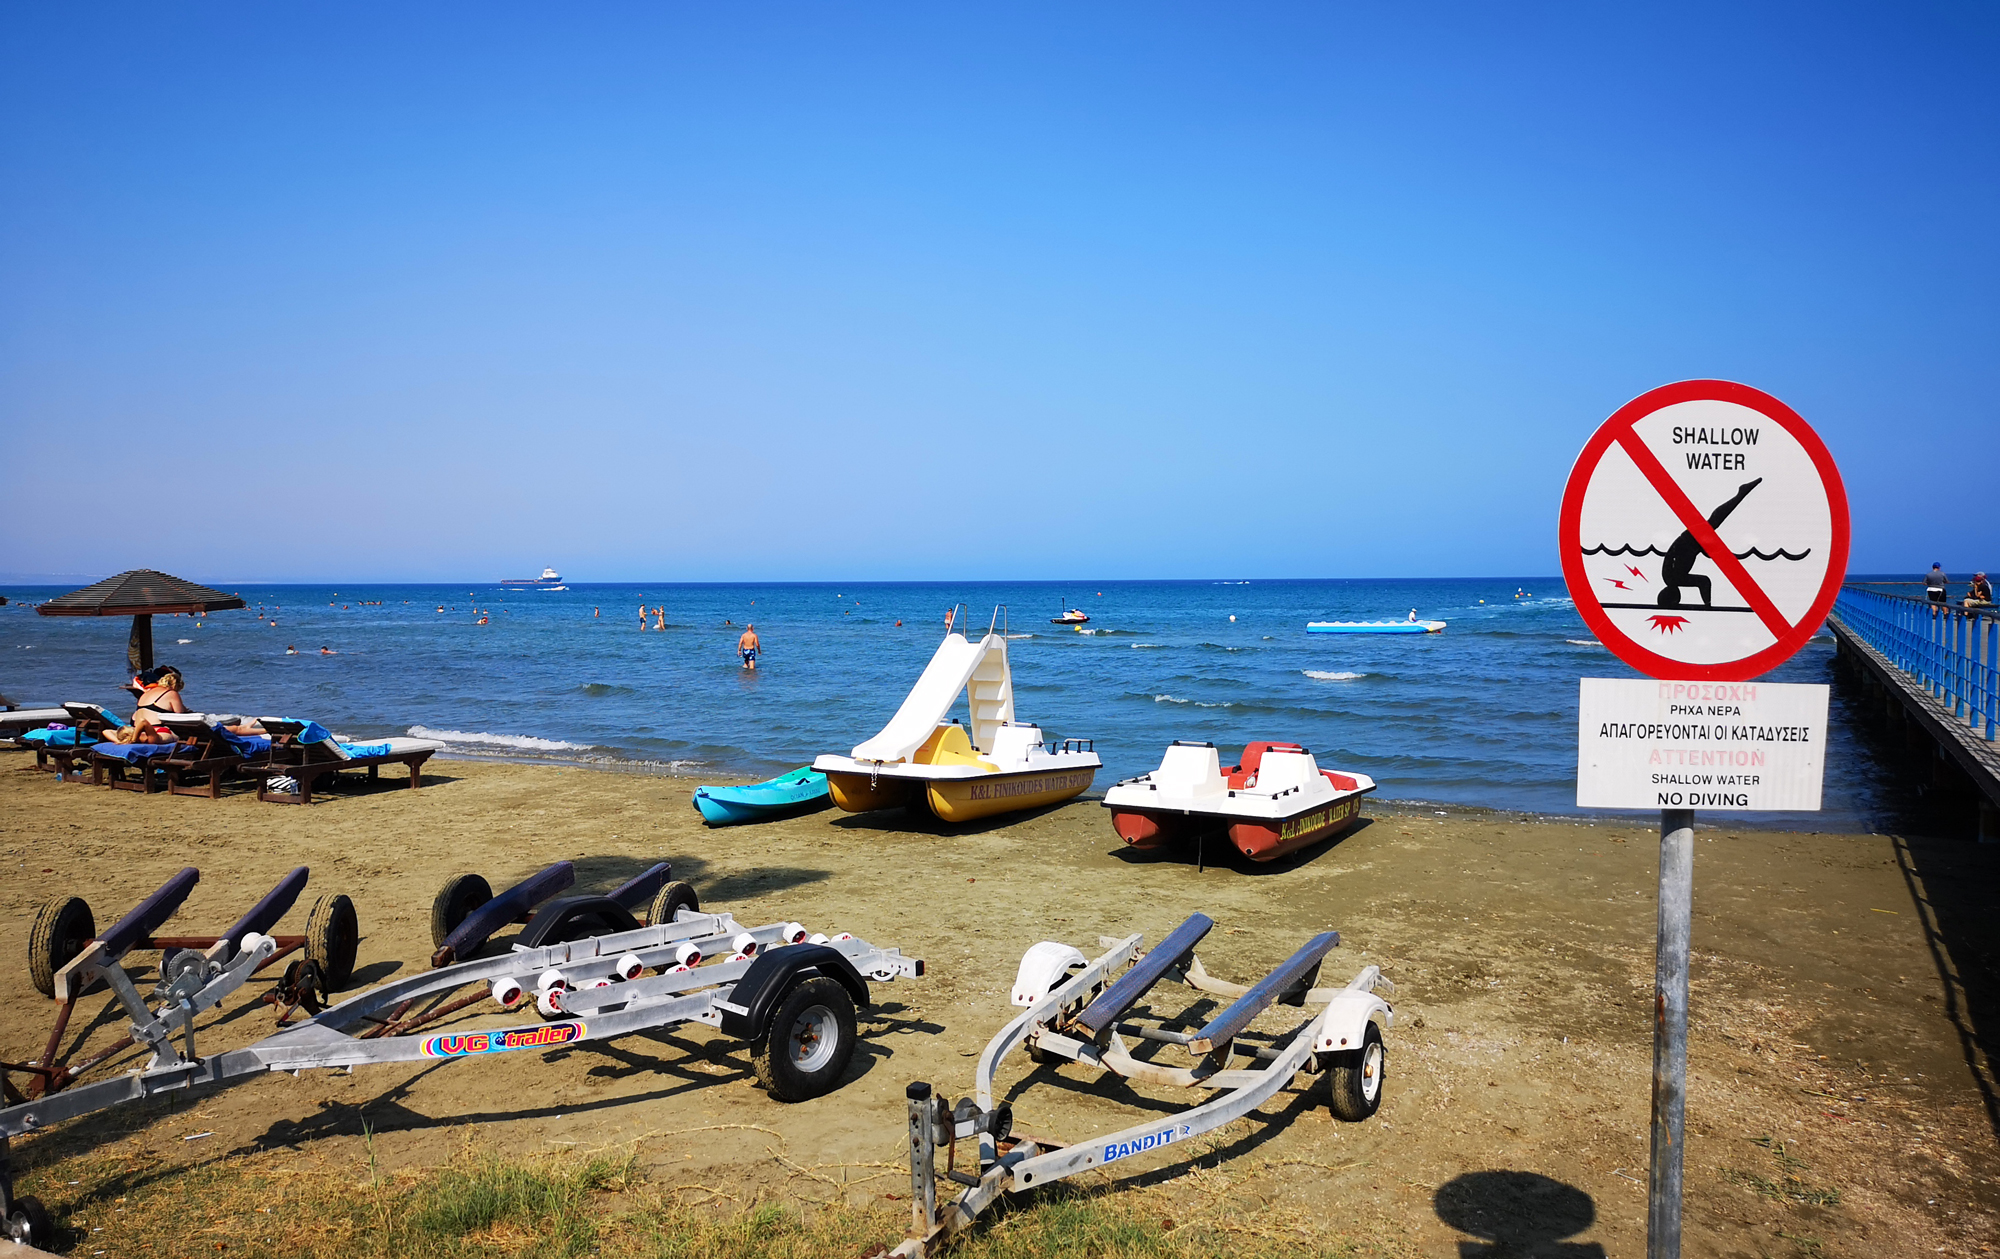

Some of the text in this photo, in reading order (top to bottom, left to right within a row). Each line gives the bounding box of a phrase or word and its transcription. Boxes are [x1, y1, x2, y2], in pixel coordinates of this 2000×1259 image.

[1672, 426, 1759, 445] SHALLOW
[1686, 452, 1745, 470] WATER
[1658, 683, 1757, 701] ΠΡΟΣΟΧΗ
[1670, 704, 1741, 716] ΡΗΧΑ ΝΕΡΑ
[1599, 723, 1809, 742] ΑΠΑΓΟΡΕΥΟΝΤΑΙ ΟΙ ΚΑΤΑΔΥΣΕΙΣ
[1649, 748, 1765, 767] ATTENTION
[970, 772, 1092, 800] K&L FINIKOUDES WATER SPORTS
[1651, 774, 1760, 786] SHALLOW WATER
[1657, 792, 1748, 807] NO DIVING
[441, 1026, 573, 1055] VG trailer
[1103, 1128, 1174, 1162] BANDIT
